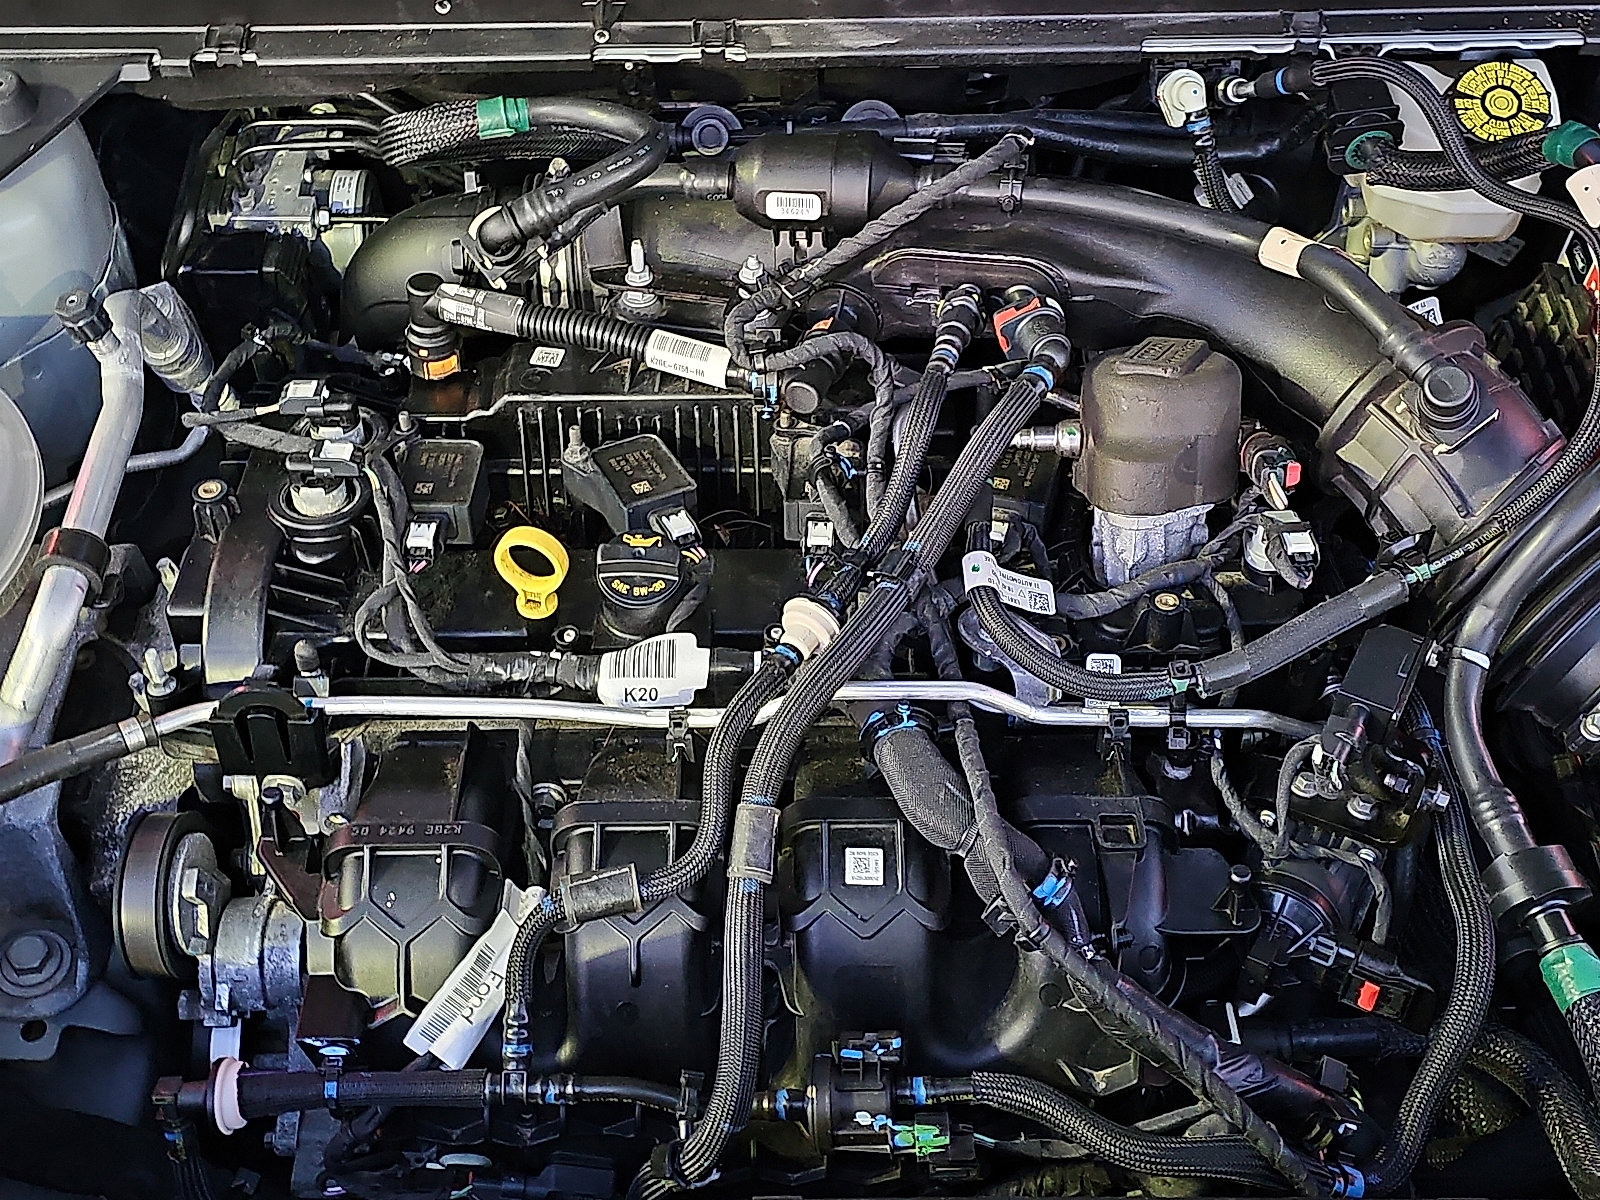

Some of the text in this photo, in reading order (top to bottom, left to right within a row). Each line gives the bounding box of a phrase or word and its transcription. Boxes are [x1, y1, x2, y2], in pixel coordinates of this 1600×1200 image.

[611, 579, 631, 594] SAE
[624, 687, 659, 703] K20
[461, 969, 505, 1026] Ford
